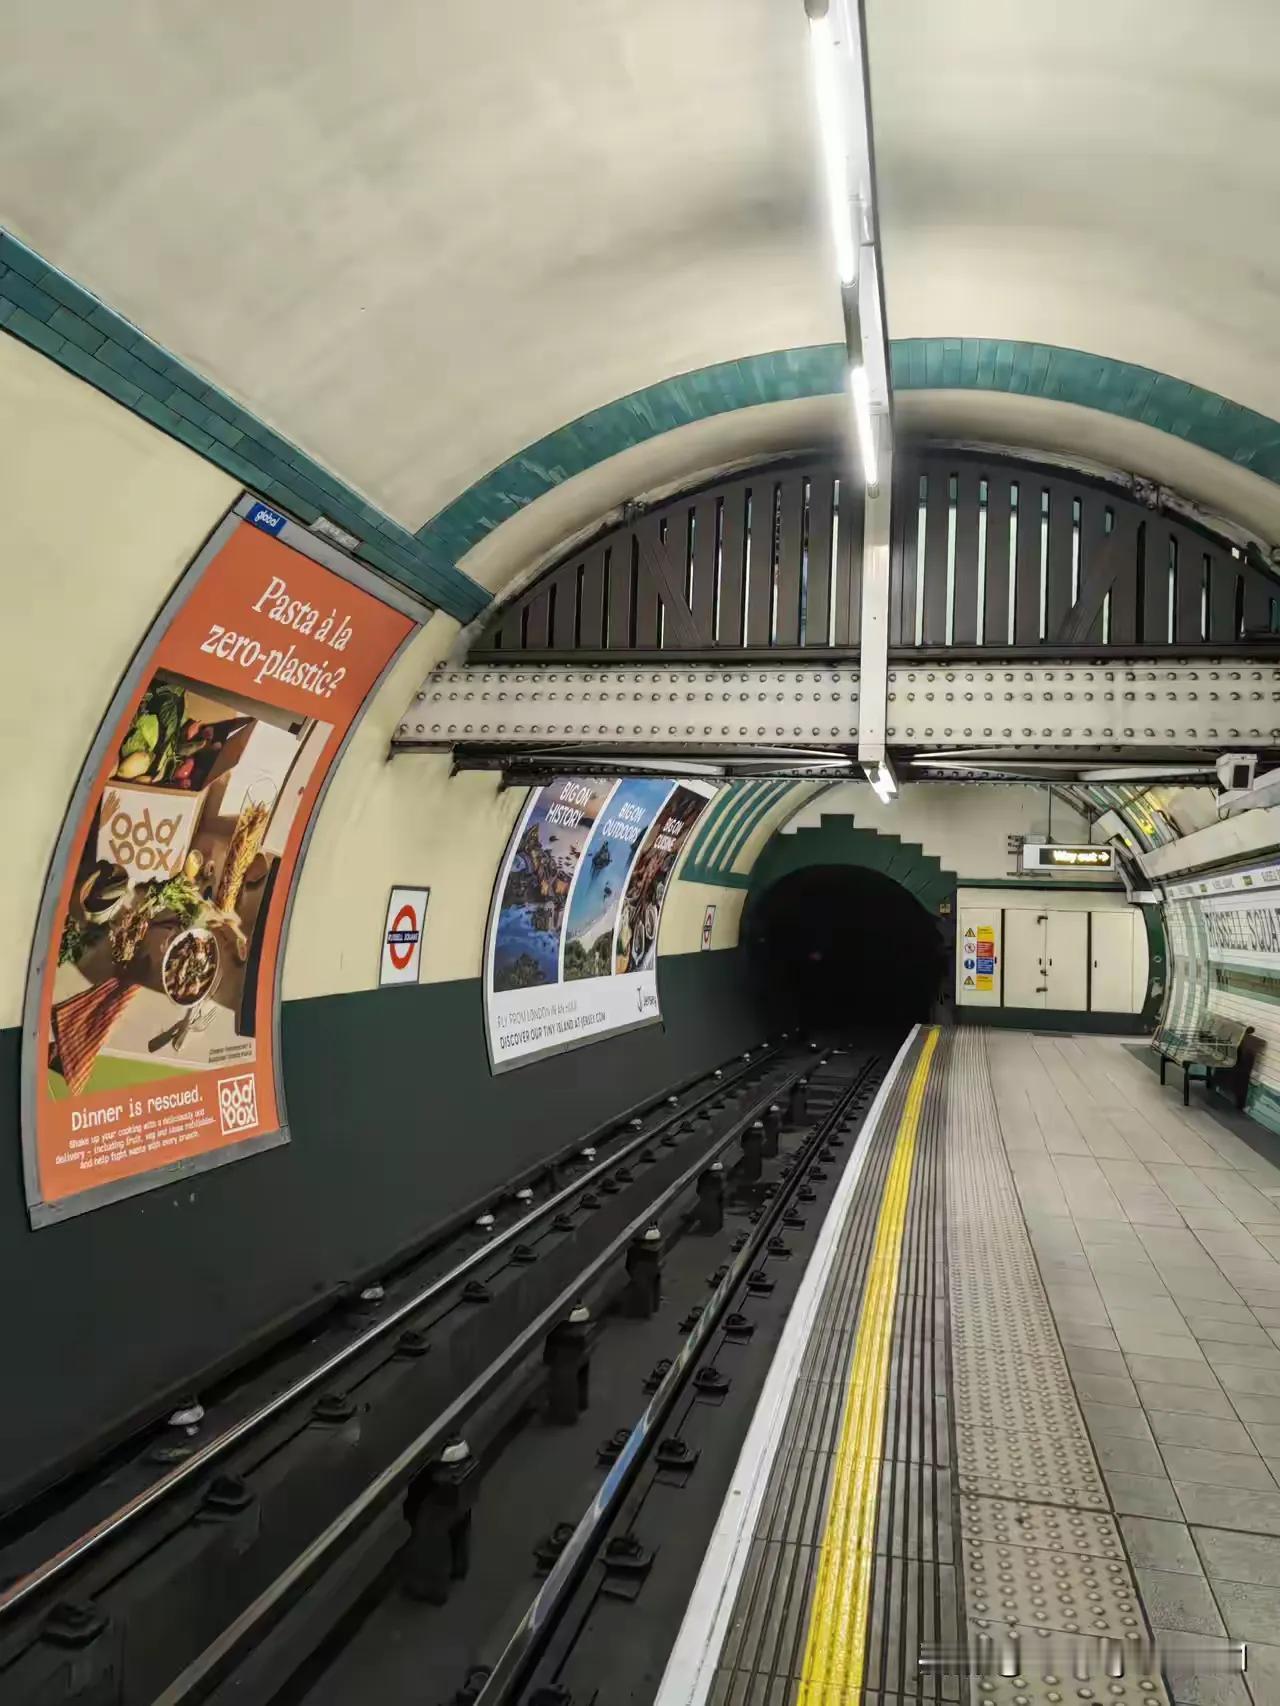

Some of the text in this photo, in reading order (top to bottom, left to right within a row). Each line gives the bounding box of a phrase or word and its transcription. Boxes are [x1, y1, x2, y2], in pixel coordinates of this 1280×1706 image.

[254, 508, 280, 528] global
[252, 576, 353, 651] Pasta à la
[200, 624, 347, 698] zero-plastic?
[560, 781, 592, 807] BIG ON
[545, 802, 585, 828] HISTORY
[618, 802, 645, 823] BIG ON
[110, 808, 183, 848] odd
[108, 840, 173, 871] box
[1246, 907, 1280, 953] SQUA
[500, 1030, 530, 1049] DISCOVER
[530, 1026, 543, 1041] OUR
[543, 1023, 556, 1037] TINY
[556, 1019, 573, 1033] ISLAND
[71, 1084, 204, 1132] Dinner is rescued.
[221, 1079, 254, 1109] odd
[222, 1103, 256, 1128] box
